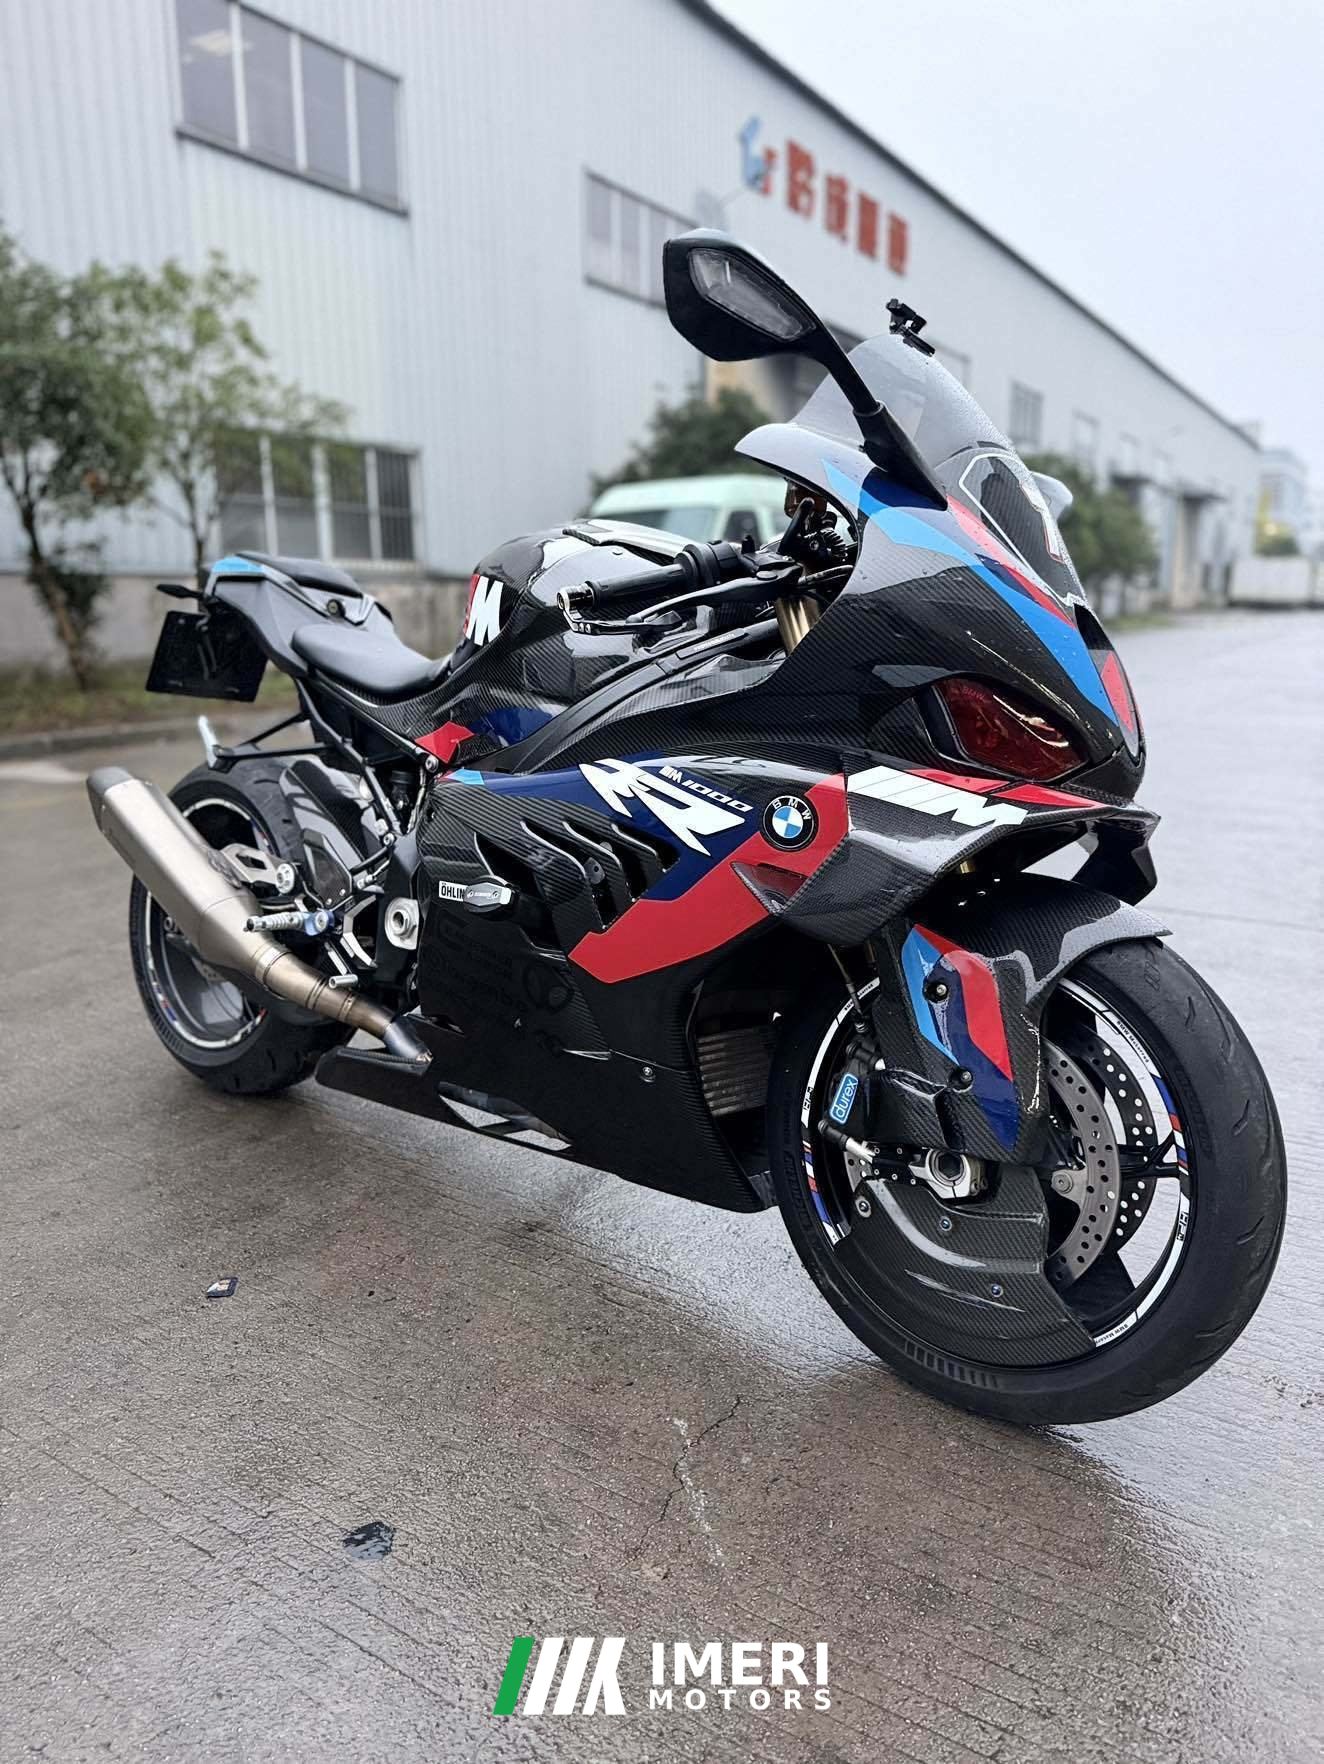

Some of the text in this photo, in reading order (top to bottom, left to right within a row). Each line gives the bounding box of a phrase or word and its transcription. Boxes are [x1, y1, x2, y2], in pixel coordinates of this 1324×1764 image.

[465, 575, 504, 647] M
[441, 882, 466, 900] ÖHLIN
[834, 1079, 858, 1119] durex
